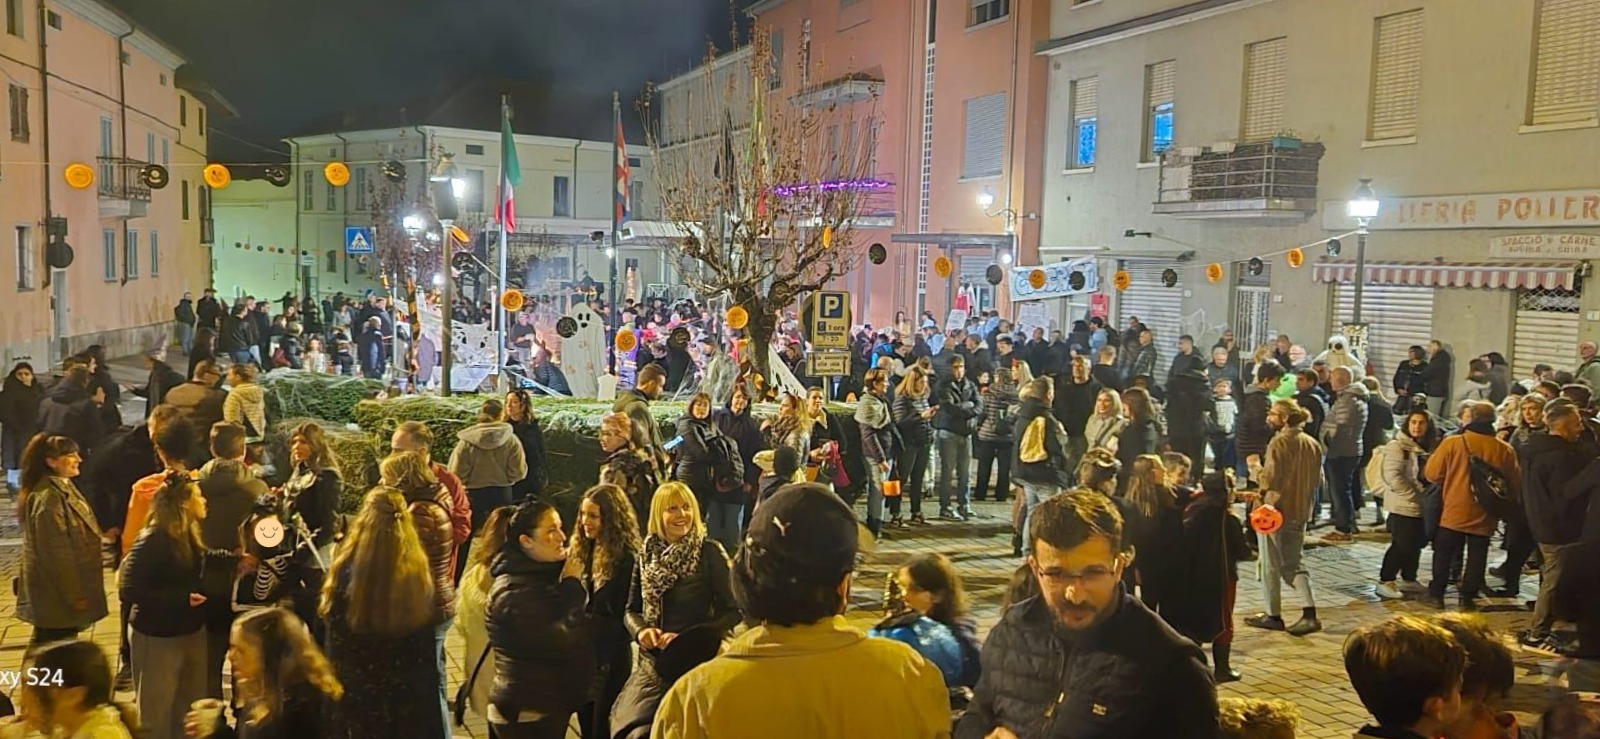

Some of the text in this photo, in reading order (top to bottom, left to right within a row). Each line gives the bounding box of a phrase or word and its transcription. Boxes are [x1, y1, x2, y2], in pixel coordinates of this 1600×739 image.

[1502, 236, 1542, 246] SPACCIO
[1560, 236, 1596, 246] CARNE
[824, 295, 840, 316] P
